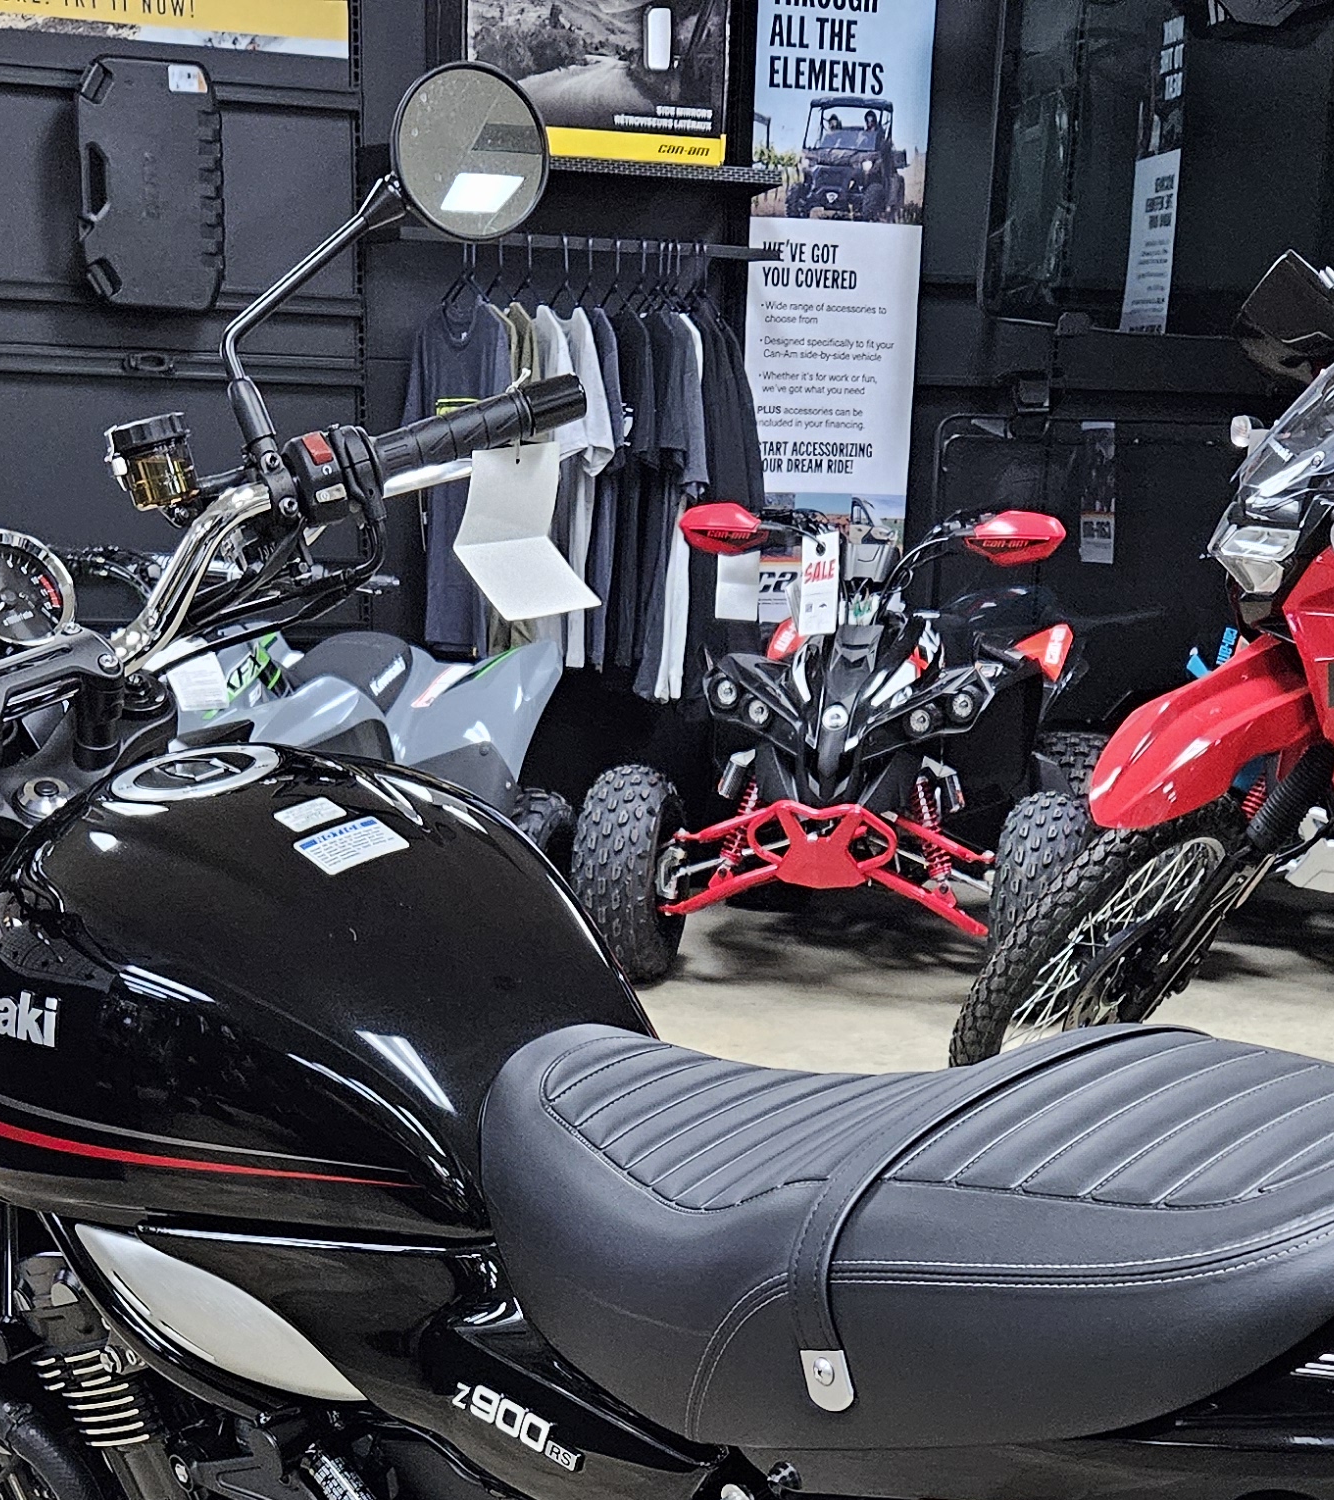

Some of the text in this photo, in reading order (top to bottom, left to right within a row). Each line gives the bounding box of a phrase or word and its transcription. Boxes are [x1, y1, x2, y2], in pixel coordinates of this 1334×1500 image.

[769, 14, 858, 52] ALL THE
[769, 55, 884, 95] ELEMENTS
[812, 243, 839, 264] GOT
[762, 266, 857, 290] YOU COVERED
[765, 301, 887, 315] Wide range of accessories to
[765, 314, 818, 324] choose from
[764, 336, 894, 351] Designed specifically to fit your
[763, 349, 882, 362] Can-Am side-by-side vehicle
[762, 371, 878, 384] Whether it's for work or fun,
[762, 384, 865, 396] we've got what you need
[757, 405, 863, 417] PLUS accessories can be
[795, 419, 803, 428] in
[804, 420, 823, 430] your
[825, 419, 865, 431] financing.
[759, 441, 873, 458] TART ACCESSORIZING
[762, 458, 854, 474] OUR DREAM RIDE!
[804, 558, 836, 584] SALE
[549, 1444, 572, 1466] RS
